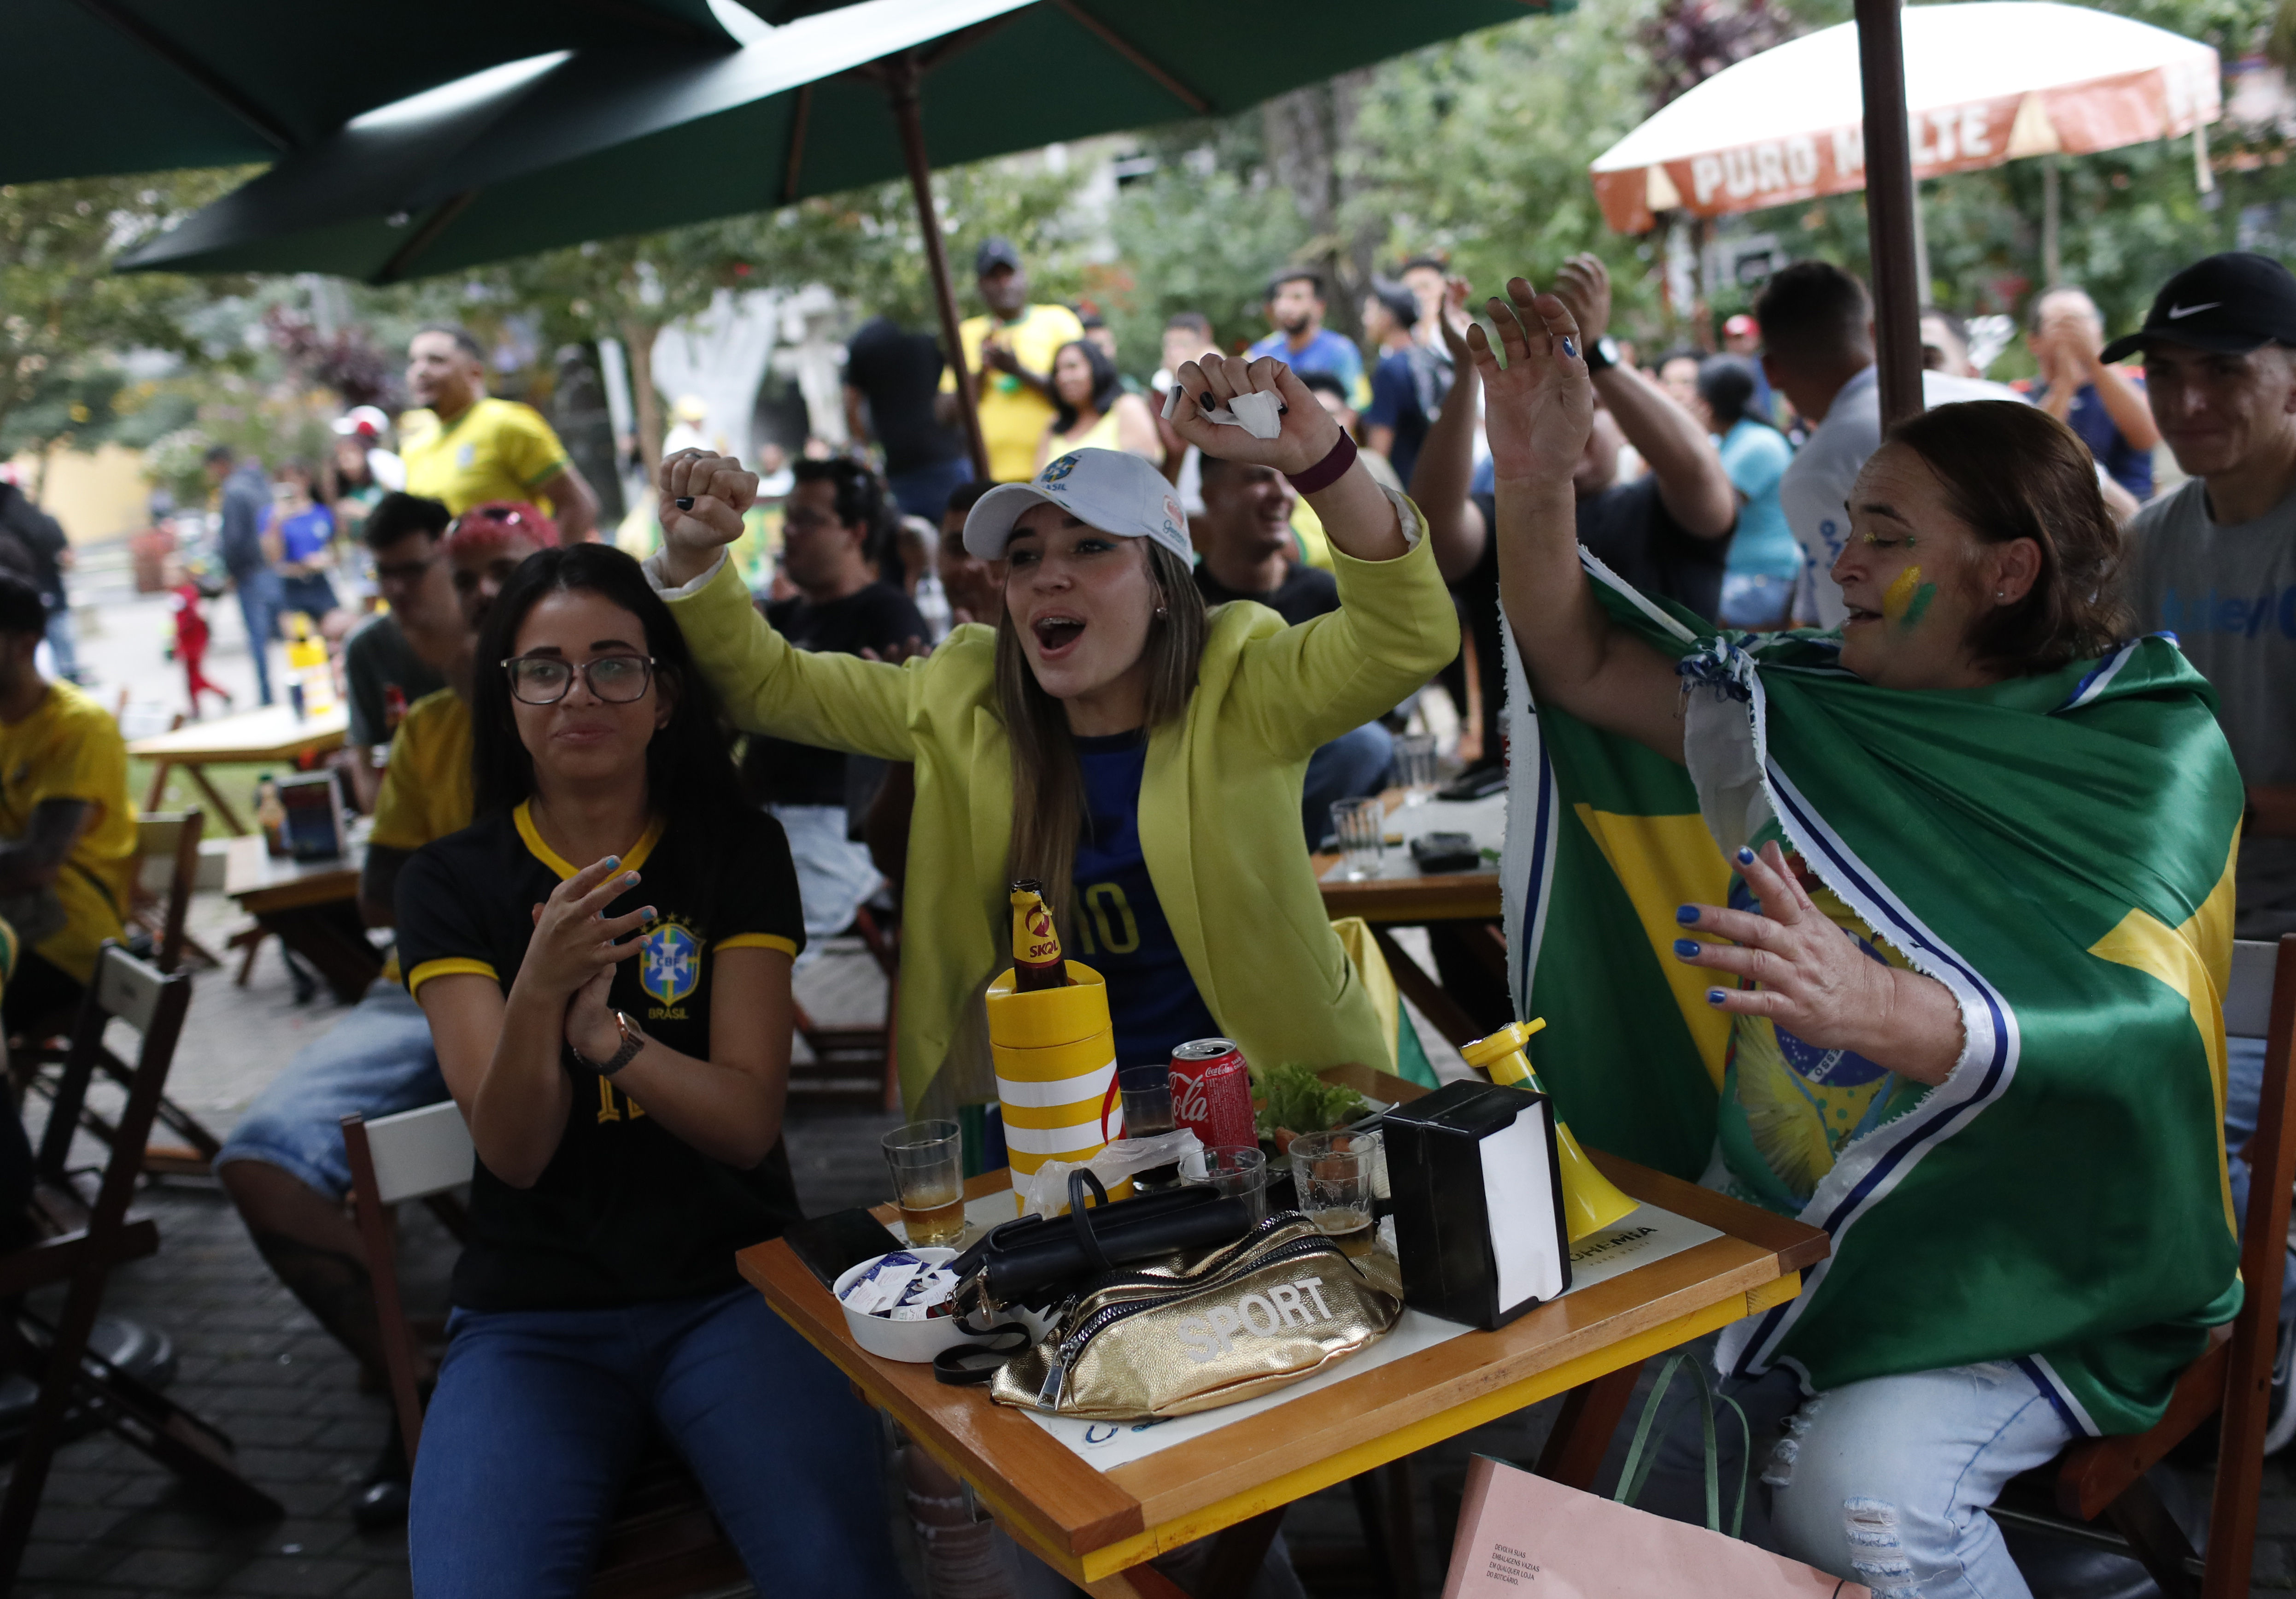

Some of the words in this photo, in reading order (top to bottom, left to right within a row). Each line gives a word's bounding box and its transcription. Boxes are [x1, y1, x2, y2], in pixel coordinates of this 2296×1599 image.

[1690, 137, 1819, 206] PURO
[1830, 104, 1991, 178] MLTE
[1070, 882, 1140, 955] 10
[1029, 940, 1059, 958] SKOL
[656, 957, 680, 967] CBF
[648, 1007, 689, 1020] BRASIL
[1570, 1227, 1658, 1262] OHEMIA
[1177, 1276, 1333, 1363] SPORT
[1495, 1543, 1513, 1555] DEVOLVA
[1514, 1549, 1526, 1558] SUAS
[1492, 1552, 1521, 1566] EMBALAGENS
[1522, 1561, 1540, 1572] VAZIAS
[1494, 1572, 1519, 1585] BOTICÁRIO.
[1497, 1564, 1520, 1576] QUALQUER
[1521, 1571, 1534, 1580] LOJA
